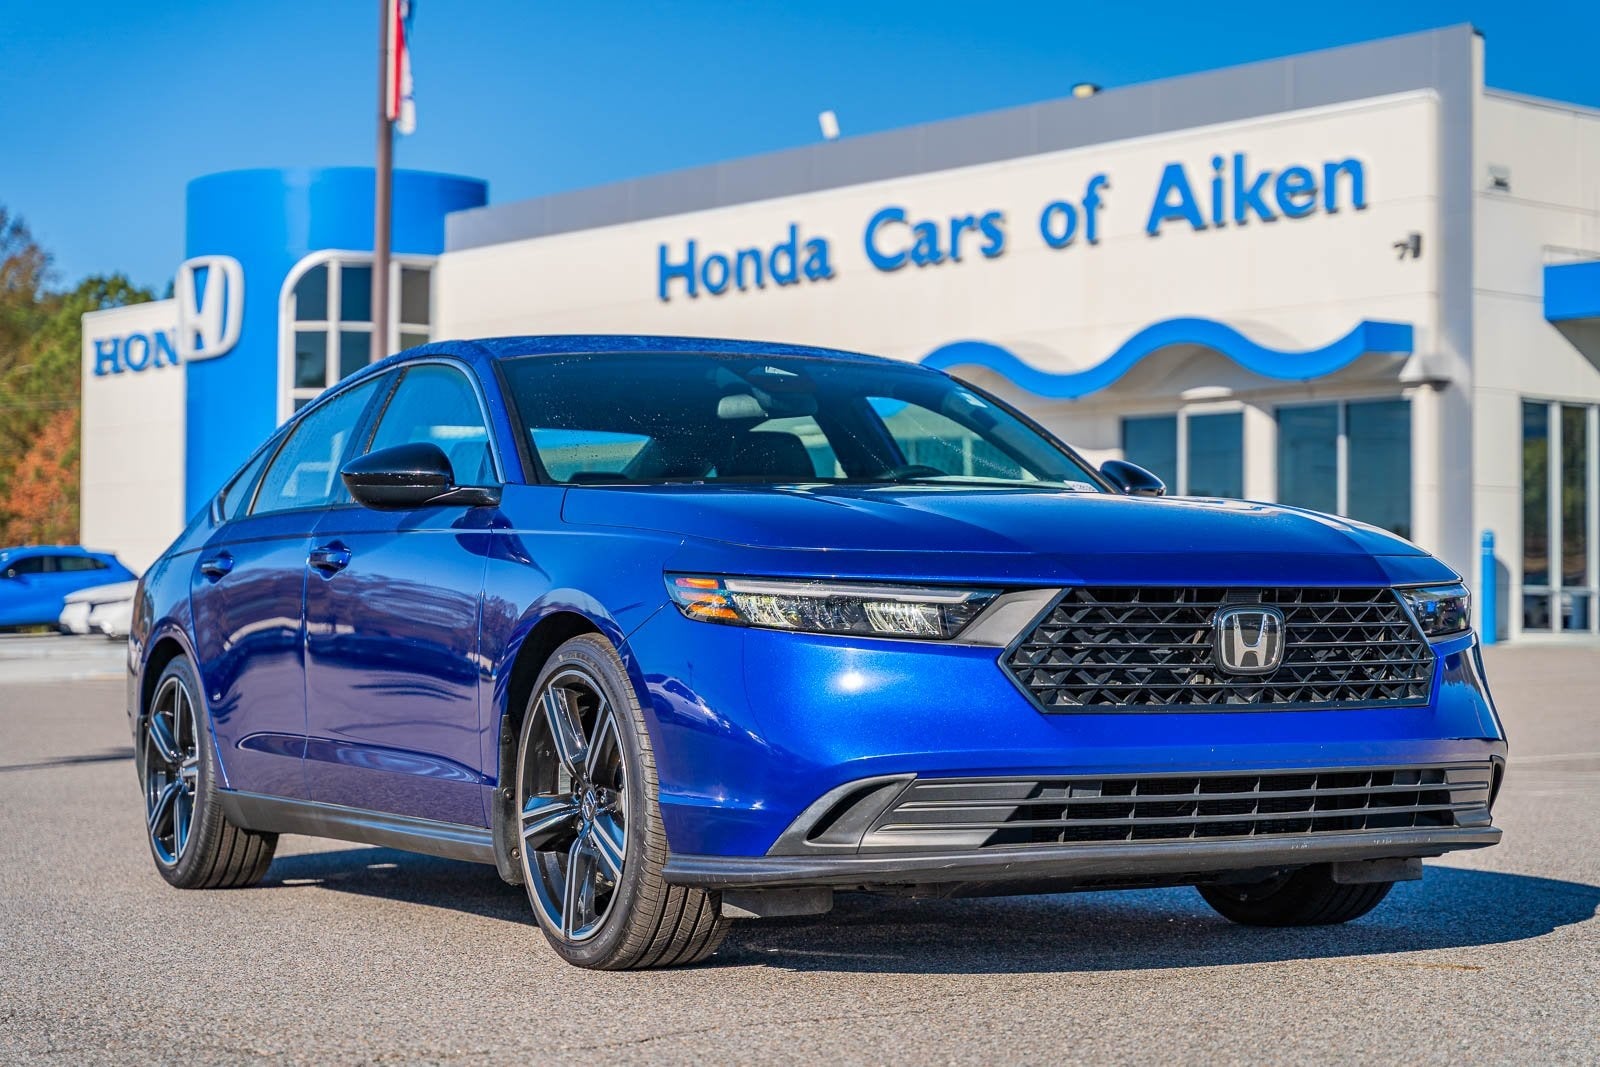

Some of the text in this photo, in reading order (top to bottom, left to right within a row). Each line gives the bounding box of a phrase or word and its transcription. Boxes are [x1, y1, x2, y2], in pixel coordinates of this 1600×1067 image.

[658, 152, 1366, 301] Honda Cars of Aiken
